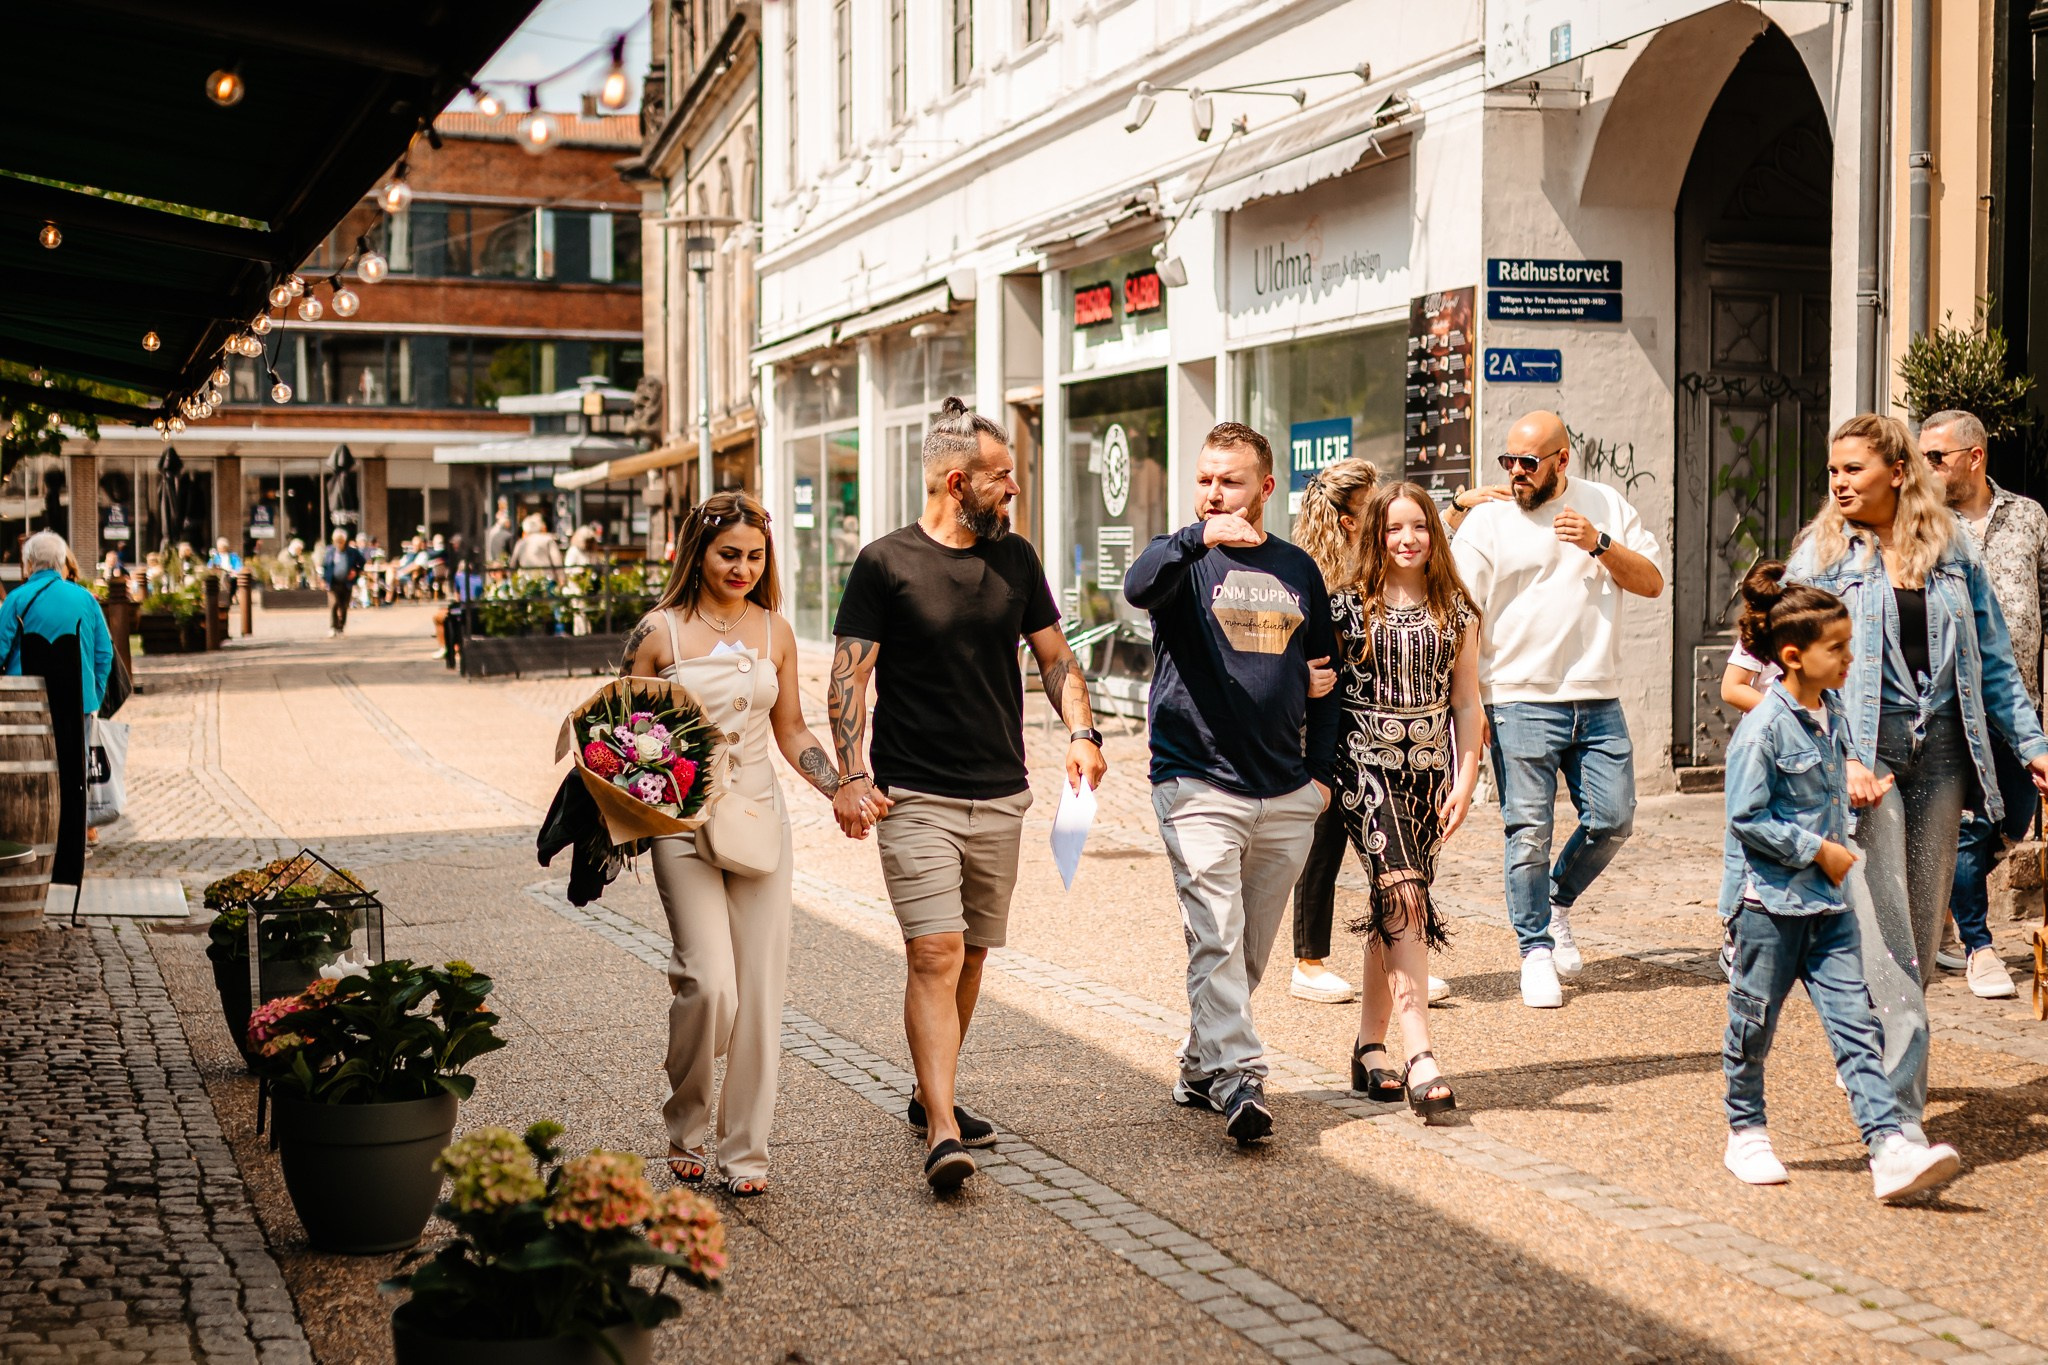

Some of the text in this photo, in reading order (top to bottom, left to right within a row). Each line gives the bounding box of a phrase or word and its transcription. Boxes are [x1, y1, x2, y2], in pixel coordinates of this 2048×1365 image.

[1254, 241, 1313, 295] Uldma
[1498, 261, 1610, 283] Rådhustorvet
[1489, 353, 1517, 376] 2A
[1292, 439, 1315, 471] TIL
[1212, 585, 1300, 606] DNM SUPPLY
